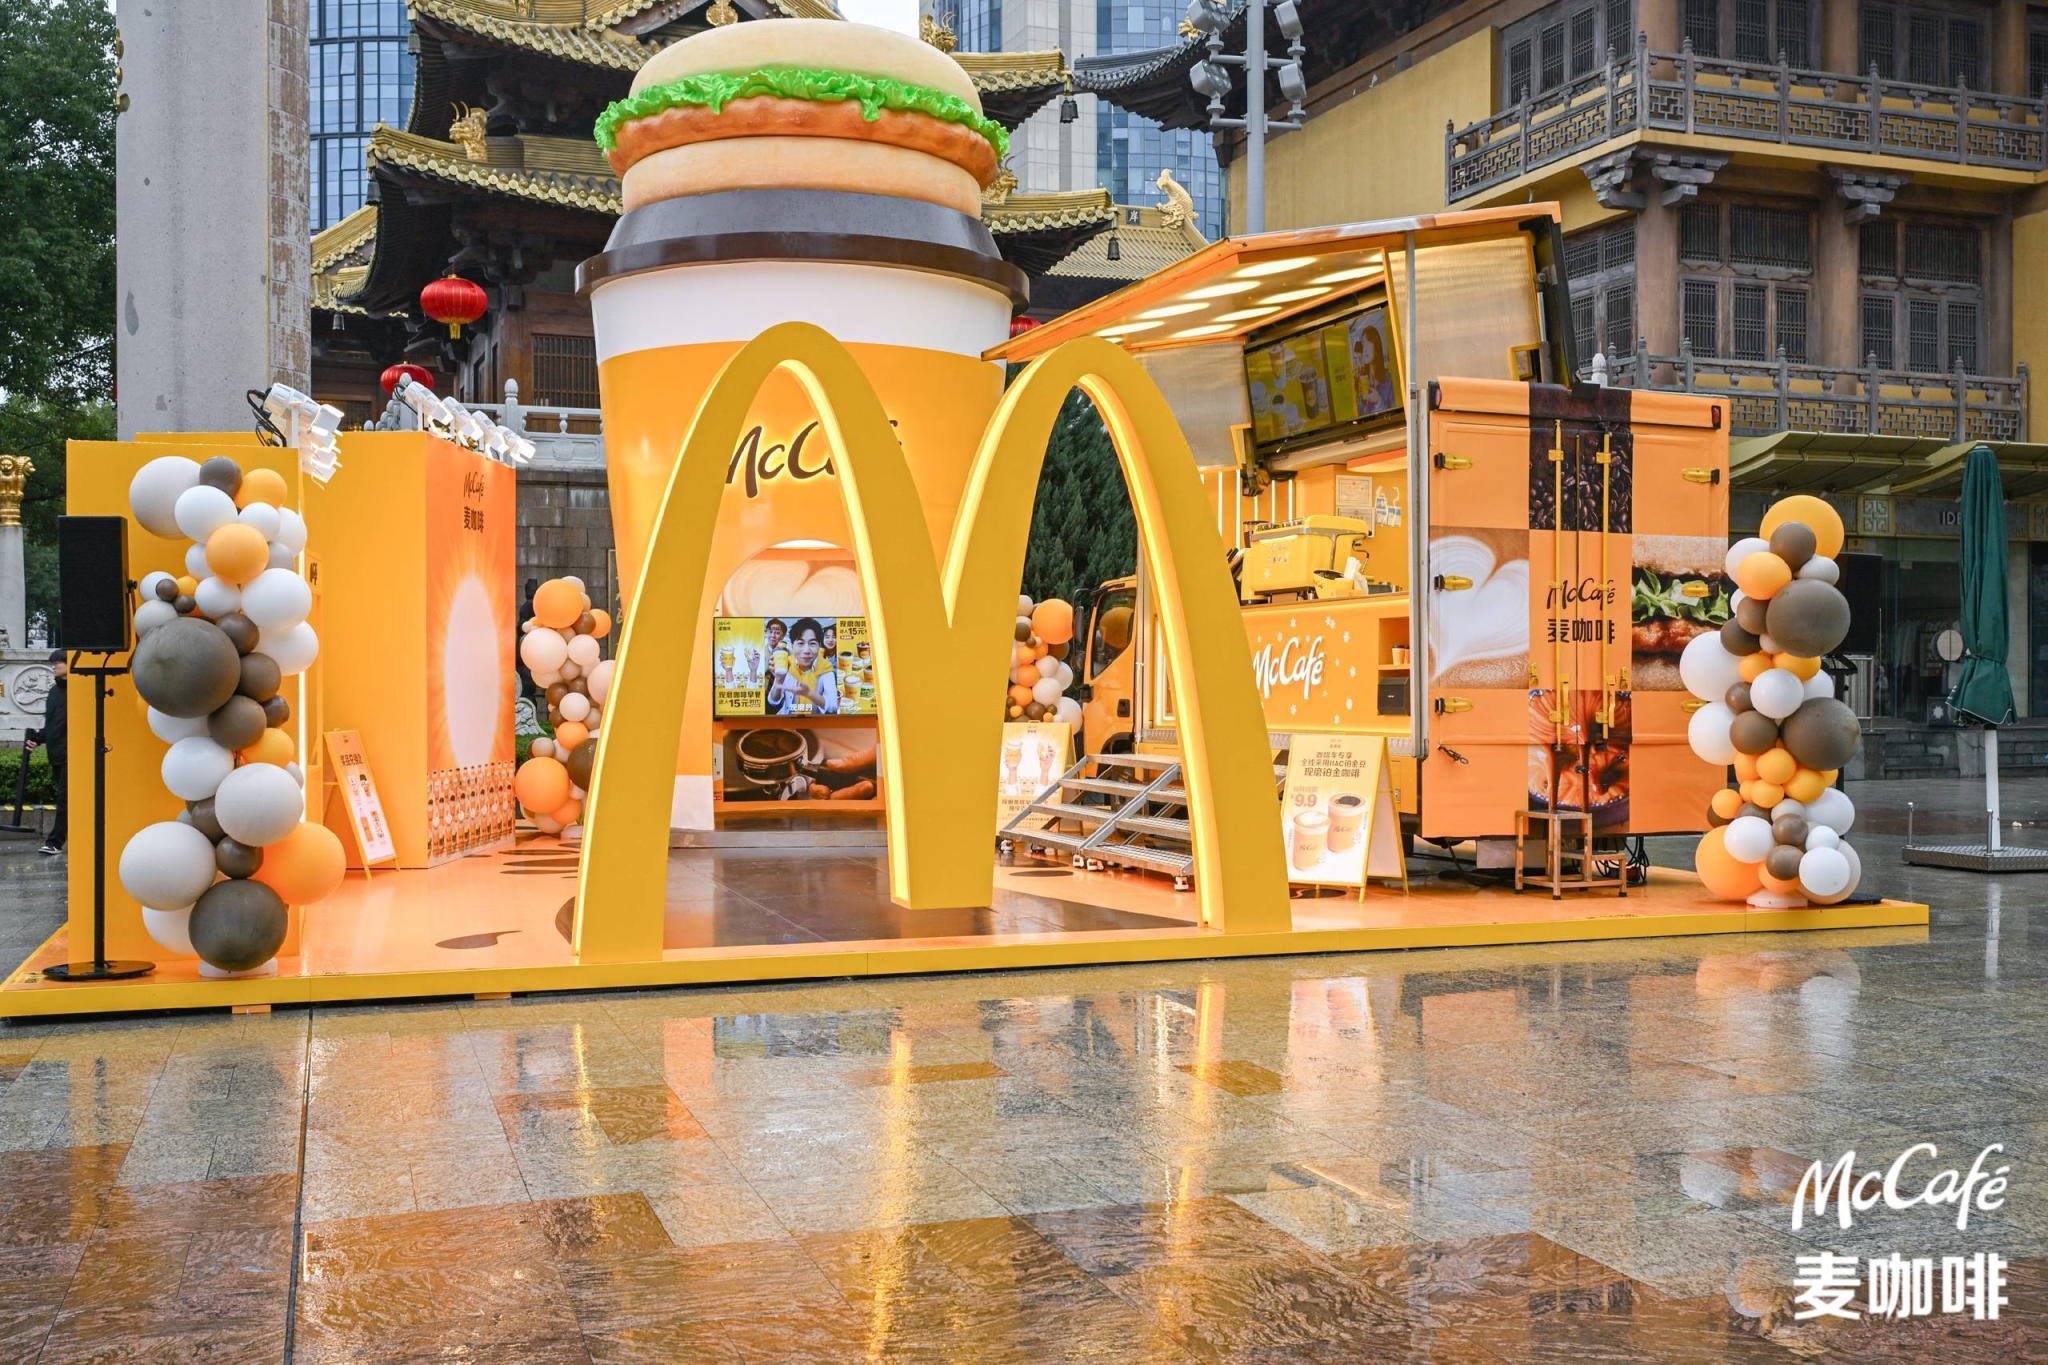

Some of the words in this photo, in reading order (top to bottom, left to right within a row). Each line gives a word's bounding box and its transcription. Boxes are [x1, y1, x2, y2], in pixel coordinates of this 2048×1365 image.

[463, 505, 484, 533] 麦咖啡
[1546, 577, 1616, 610] McCafé
[1547, 618, 1616, 644] 麦咖啡
[1253, 635, 1326, 700] McCafé
[1316, 751, 1353, 759] 咖啡车专享
[1304, 767, 1360, 778] 现磨铂金咖啡
